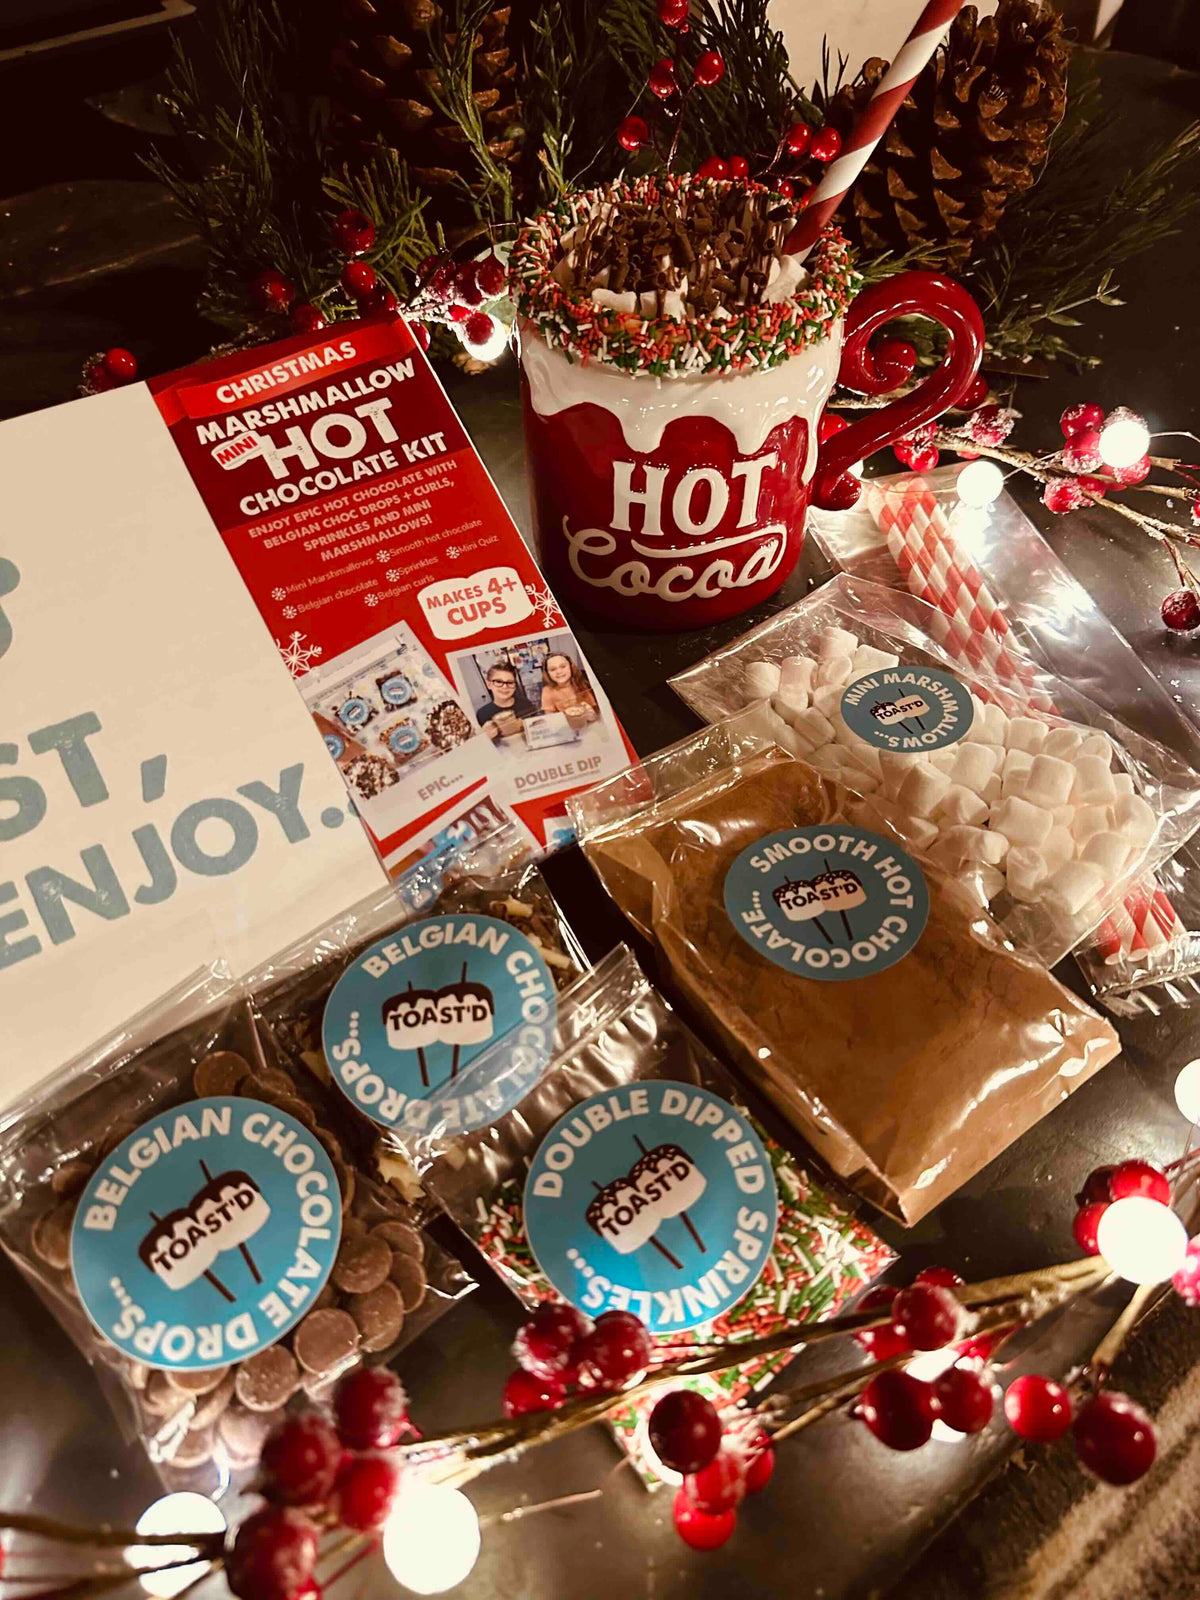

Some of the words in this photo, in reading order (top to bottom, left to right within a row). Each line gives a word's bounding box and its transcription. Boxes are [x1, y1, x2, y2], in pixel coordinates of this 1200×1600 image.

[216, 341, 356, 404] CHRISTMAS
[196, 358, 415, 445] MARSHMALLOW
[216, 435, 258, 466] MINI
[259, 397, 399, 480] HOT
[239, 450, 399, 516] CHOCOLATE
[402, 431, 448, 463] KIT
[248, 515, 291, 539] ENJOY
[293, 504, 322, 523] EPIC
[323, 496, 350, 513] HOT
[352, 472, 424, 502] CHOCOLATE
[424, 459, 458, 477] WITH
[609, 450, 779, 536] HOT
[263, 522, 321, 549] BELGIAN
[322, 509, 359, 529] CHOC
[359, 495, 401, 516] DROPS
[413, 476, 455, 497] CURLS,
[303, 520, 371, 552] SPRINKLES
[373, 510, 401, 527] AND
[403, 499, 432, 516] MINI
[320, 513, 433, 562] MARSHMALLOWS!
[389, 538, 425, 557] Smooth
[425, 533, 442, 544] hot
[441, 519, 483, 539] chocolate
[397, 556, 439, 577] Sprinkles
[457, 541, 478, 554] Mini
[478, 535, 500, 547] Quiz
[562, 515, 787, 602] Cocoa
[285, 580, 308, 594] Mini
[308, 557, 374, 587] Marshmallows
[297, 594, 334, 613] Belgian
[335, 578, 379, 600] chocolate
[377, 582, 413, 601] Belgian
[412, 574, 436, 589] curls
[426, 585, 483, 610] MAKES
[487, 577, 517, 595] 4+
[447, 596, 507, 625] CUPS
[844, 677, 880, 706] MINI
[876, 699, 924, 720] TOAST'D
[514, 763, 575, 789] DOUBLE
[576, 755, 602, 772] DIP
[750, 833, 878, 873] SMOOTH
[873, 856, 914, 909] HOT
[781, 882, 858, 911] TOAST'D
[361, 922, 510, 979] BELGIAN
[390, 1004, 488, 1031] TOAST'D
[533, 1089, 649, 1198] DOUBLE
[660, 1088, 766, 1194] DIPPED
[83, 1106, 231, 1231] BELGIAN
[242, 1113, 333, 1328] CHOCOLATE
[602, 1160, 691, 1236] TOAST'D
[154, 1188, 256, 1272] TOAST'D
